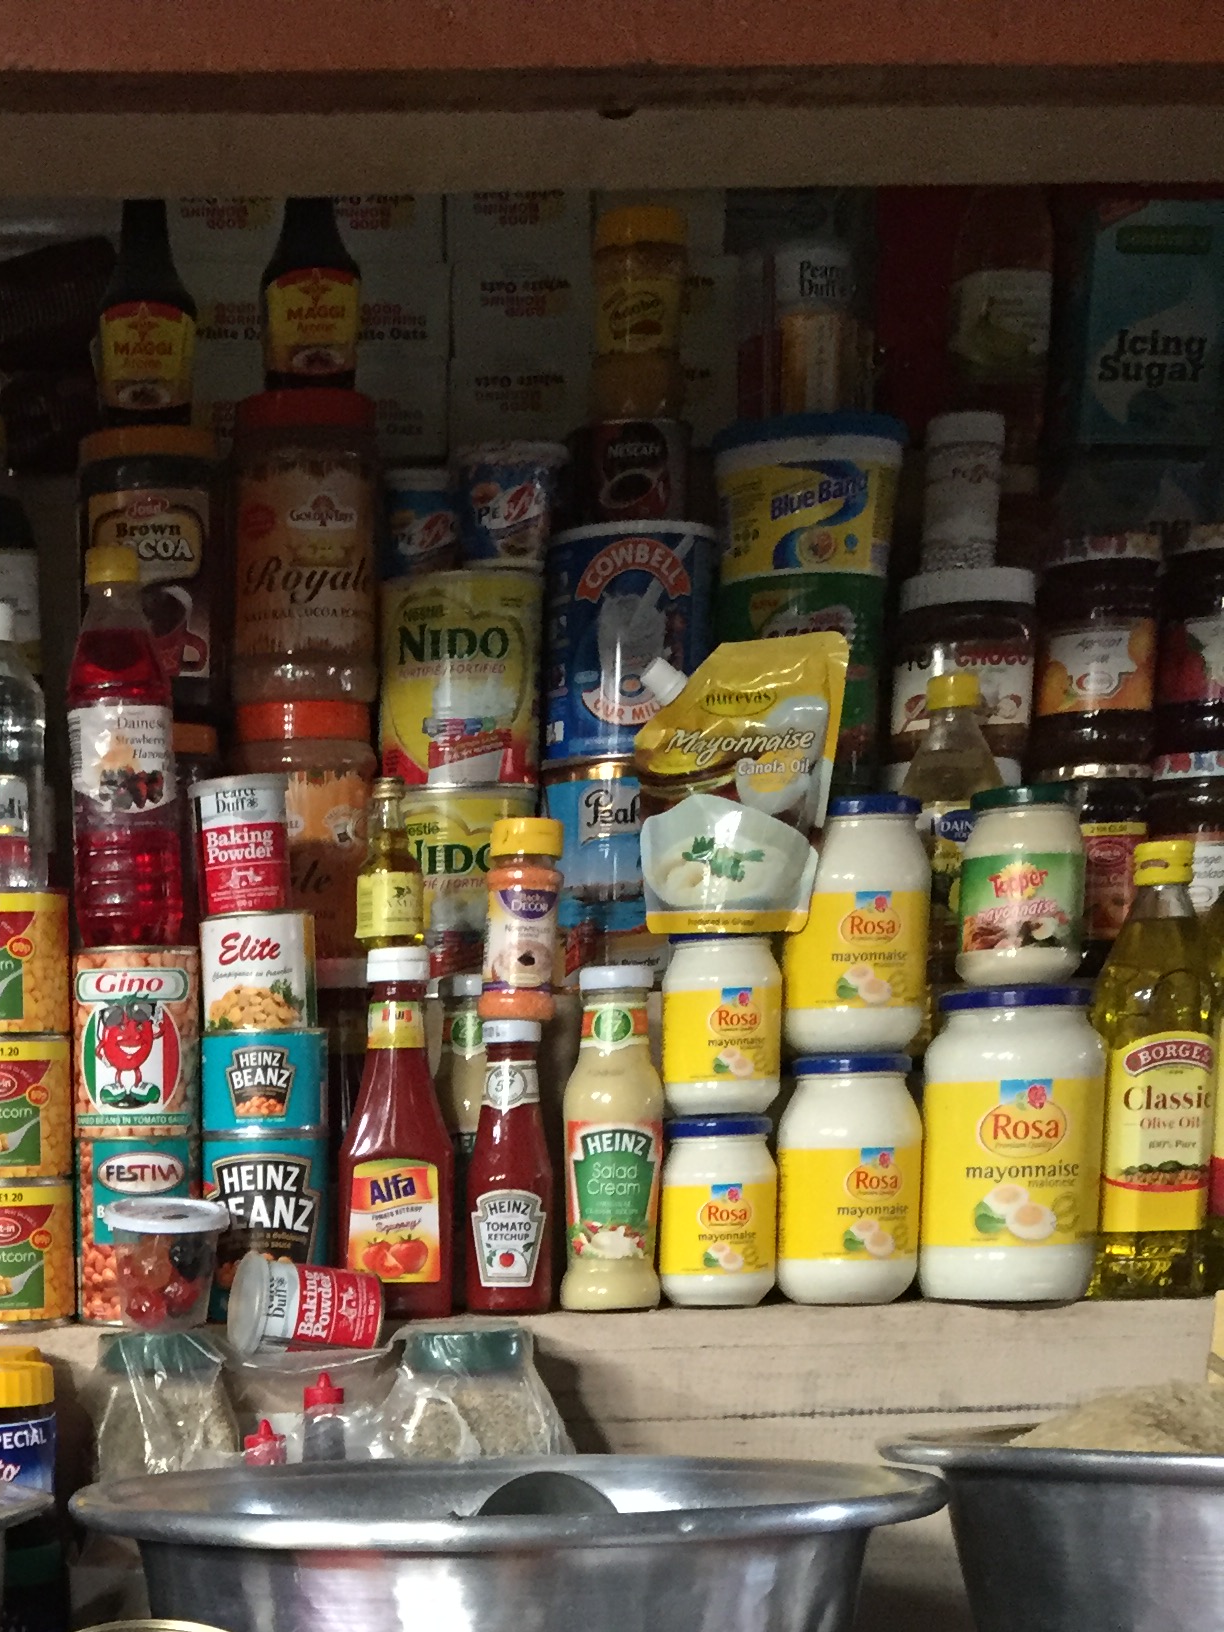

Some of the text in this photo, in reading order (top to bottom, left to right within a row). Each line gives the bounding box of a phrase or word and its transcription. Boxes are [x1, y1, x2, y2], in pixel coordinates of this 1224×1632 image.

[287, 305, 346, 323] MAGGI
[114, 340, 174, 358] MAGGI
[1118, 329, 1208, 362] Icing
[1099, 354, 1205, 388] Sugar
[771, 470, 868, 521] Blue Band
[115, 522, 181, 538] Brown
[585, 540, 685, 590] COWBELL
[397, 623, 510, 665] NIDO
[664, 726, 816, 766] Mayonnaise
[737, 757, 811, 776] Canola Oil
[215, 797, 248, 815] Duff
[205, 827, 274, 850] Baking
[206, 843, 274, 864] Powder
[988, 866, 1050, 899] Topper
[849, 914, 898, 938] Rosa
[217, 931, 282, 967] Elite
[830, 948, 908, 967] mayonnaise
[95, 971, 164, 996] Gino
[717, 1007, 758, 1028] Rosa
[706, 1035, 766, 1051] mayonnaise
[239, 1052, 282, 1068] HEINZ
[1136, 1044, 1211, 1069] BORGES
[231, 1067, 291, 1091] BEANZ
[1123, 1085, 1213, 1112] Classic
[991, 1112, 1060, 1141] Rosa
[1139, 1115, 1202, 1131] Olive Oil
[585, 1132, 647, 1157] HEINZ
[223, 1164, 301, 1195] HEINZ
[591, 1161, 639, 1179] Salad
[854, 1169, 900, 1191] Rosa
[965, 1161, 1080, 1182] mayonnaise
[369, 1174, 417, 1206] Alfa
[586, 1178, 641, 1197] Cream
[487, 1199, 532, 1217] HEINZ
[706, 1203, 748, 1223] Rosa
[836, 1203, 910, 1221] mayonnaise
[484, 1220, 532, 1234] TOMATO
[487, 1232, 530, 1243] KETCHUP
[697, 1229, 757, 1245] mayonnaise
[297, 1270, 320, 1336] Baking
[311, 1274, 331, 1339] Powder
